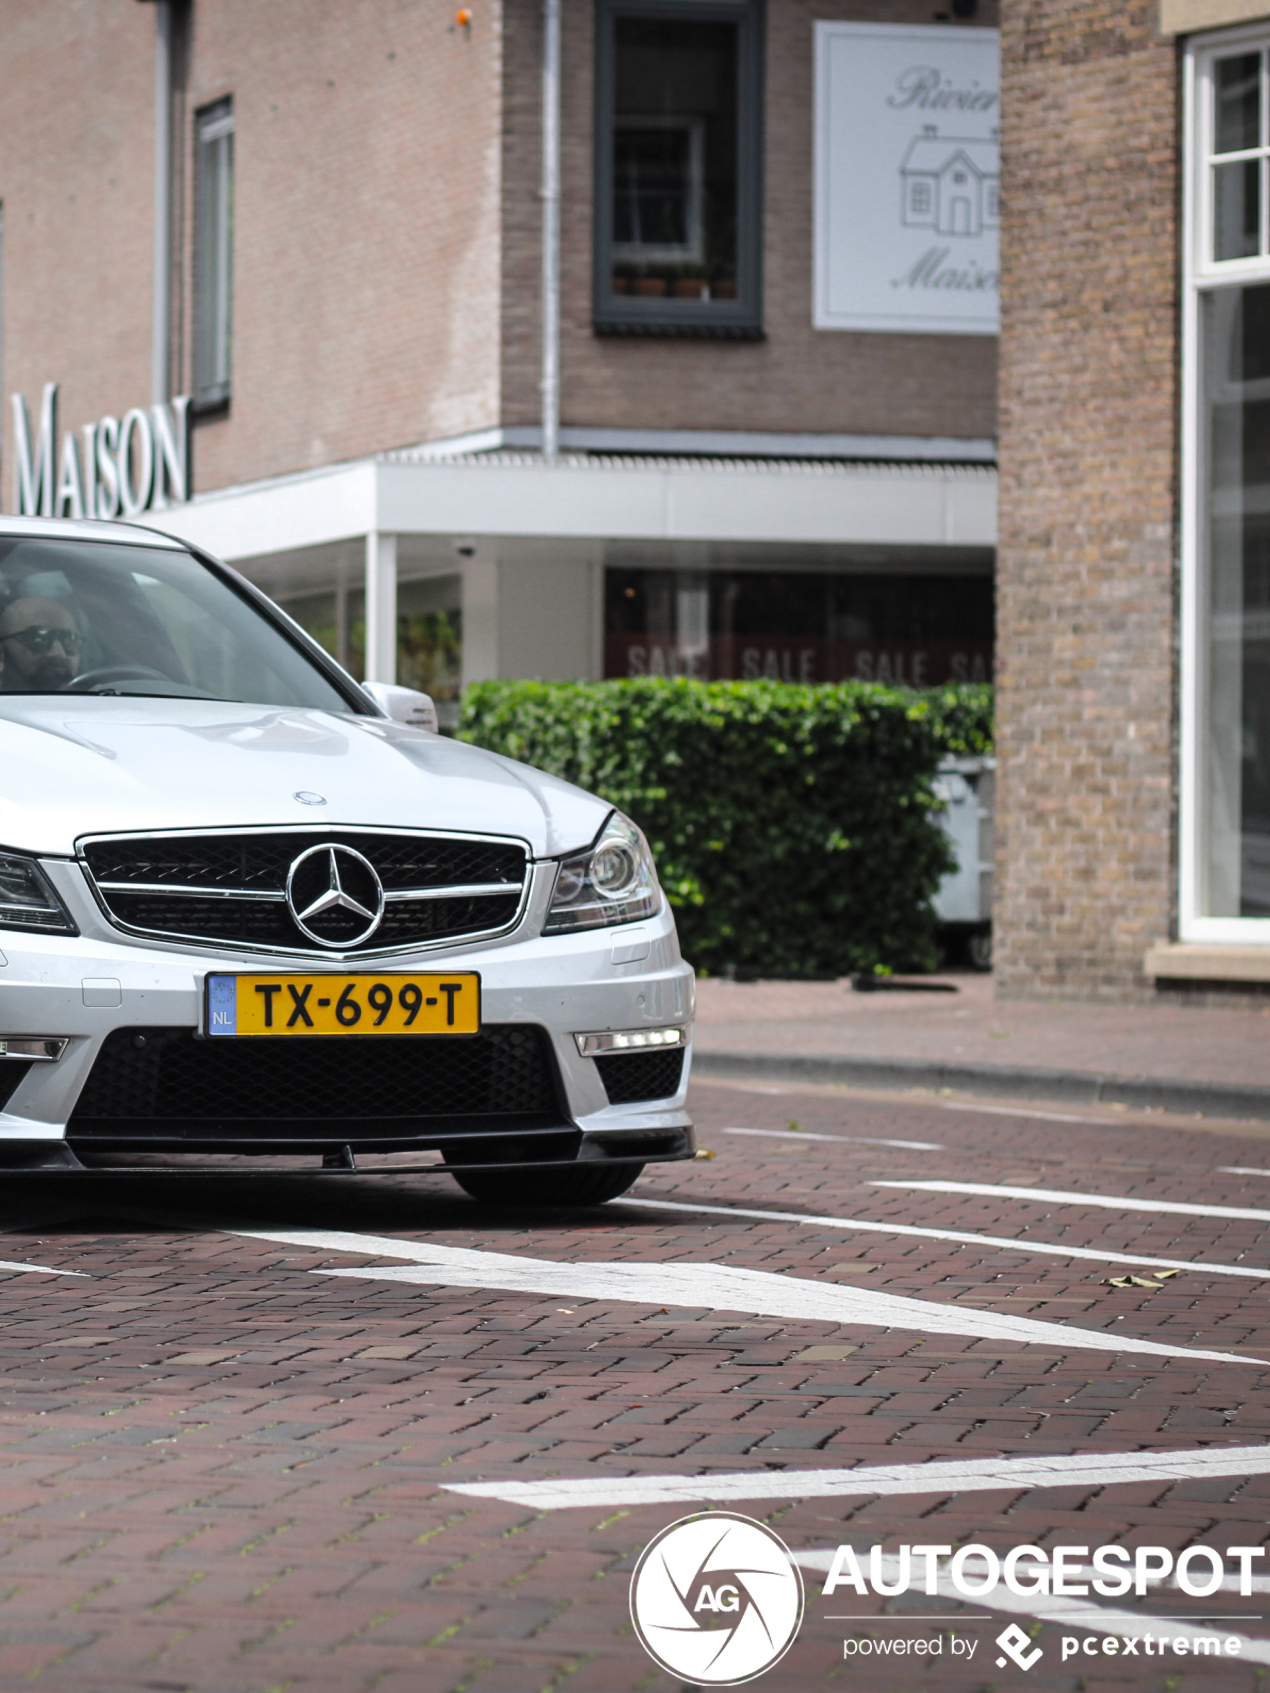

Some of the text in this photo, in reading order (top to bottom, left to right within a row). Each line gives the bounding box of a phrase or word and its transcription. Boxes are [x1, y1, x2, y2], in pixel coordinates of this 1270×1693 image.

[11, 381, 191, 520] MAISON
[742, 648, 816, 681] SALE
[856, 652, 927, 684] SALE
[213, 1011, 232, 1025] NL
[255, 983, 462, 1027] TX-699-T
